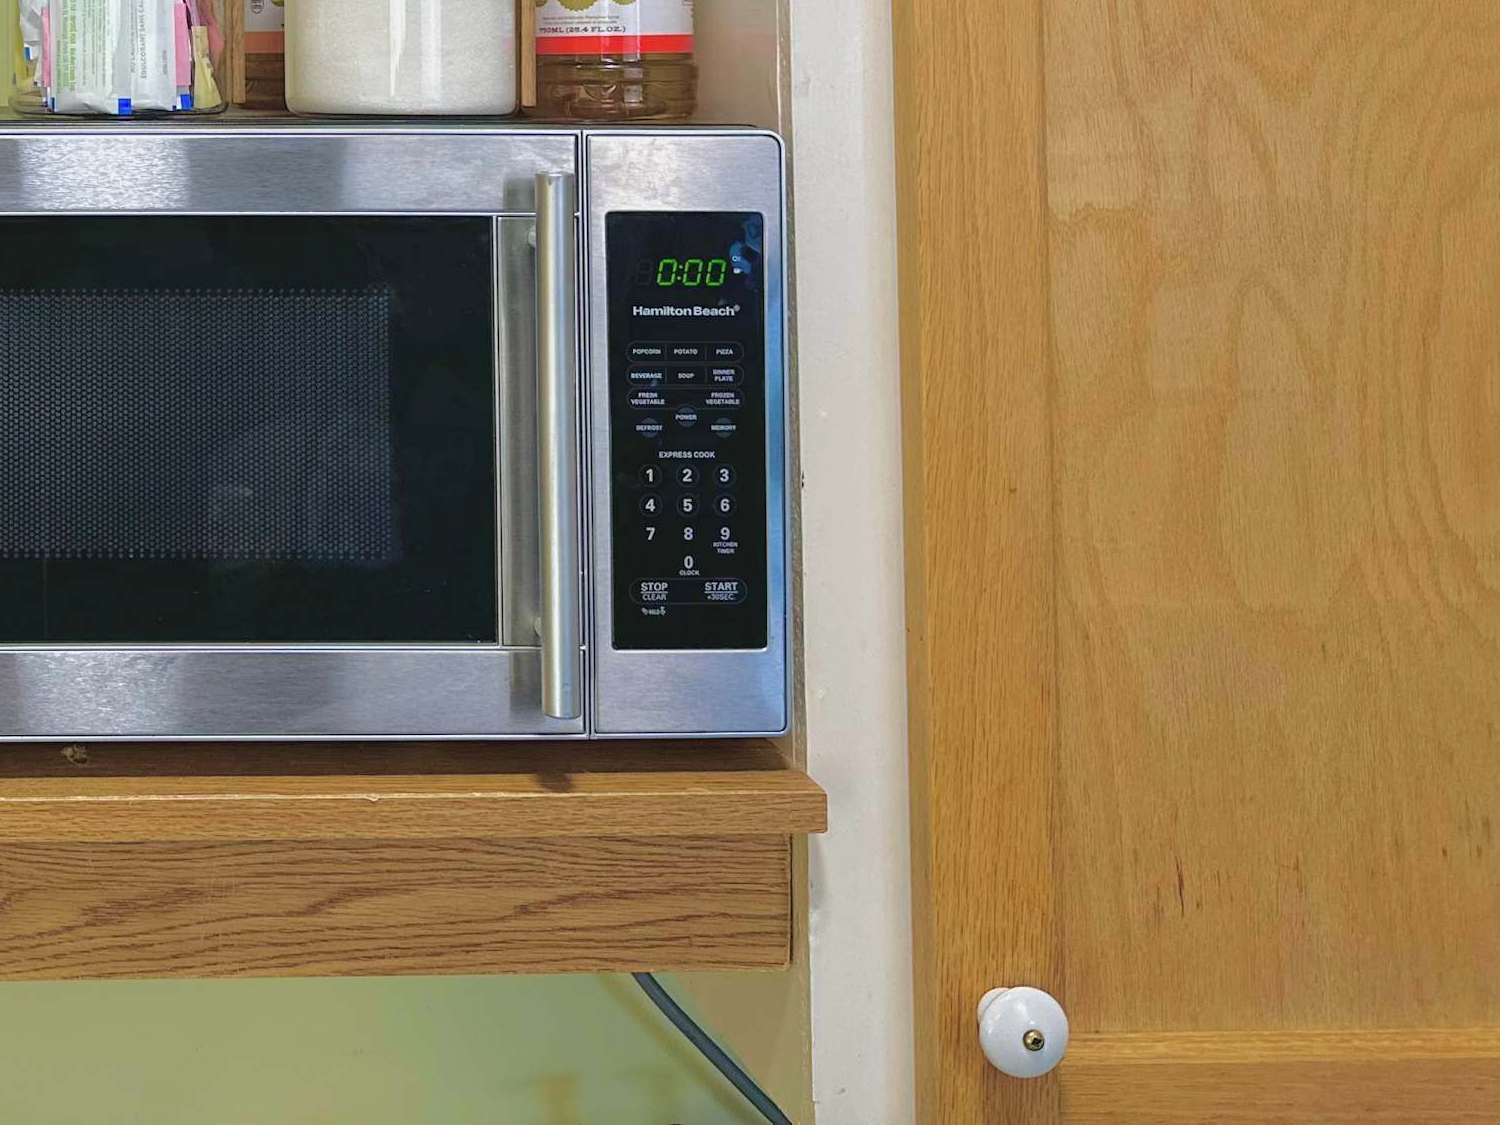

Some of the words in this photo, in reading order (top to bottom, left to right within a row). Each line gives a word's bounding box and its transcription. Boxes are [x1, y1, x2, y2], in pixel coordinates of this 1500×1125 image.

[656, 258, 726, 286] 0:00
[632, 306, 694, 316] Hamilton
[659, 451, 692, 459] EXPRESS
[693, 451, 716, 459] COOK
[645, 468, 654, 482] 1
[682, 468, 693, 482] 2
[719, 468, 729, 482] 3
[645, 498, 655, 512] 4
[683, 498, 693, 512] 5
[720, 498, 730, 512] 6
[646, 527, 655, 540] 7
[683, 527, 694, 540] 8
[720, 527, 730, 540] 9
[684, 555, 694, 569] 0
[640, 582, 668, 591] STOP
[704, 582, 738, 591] START
